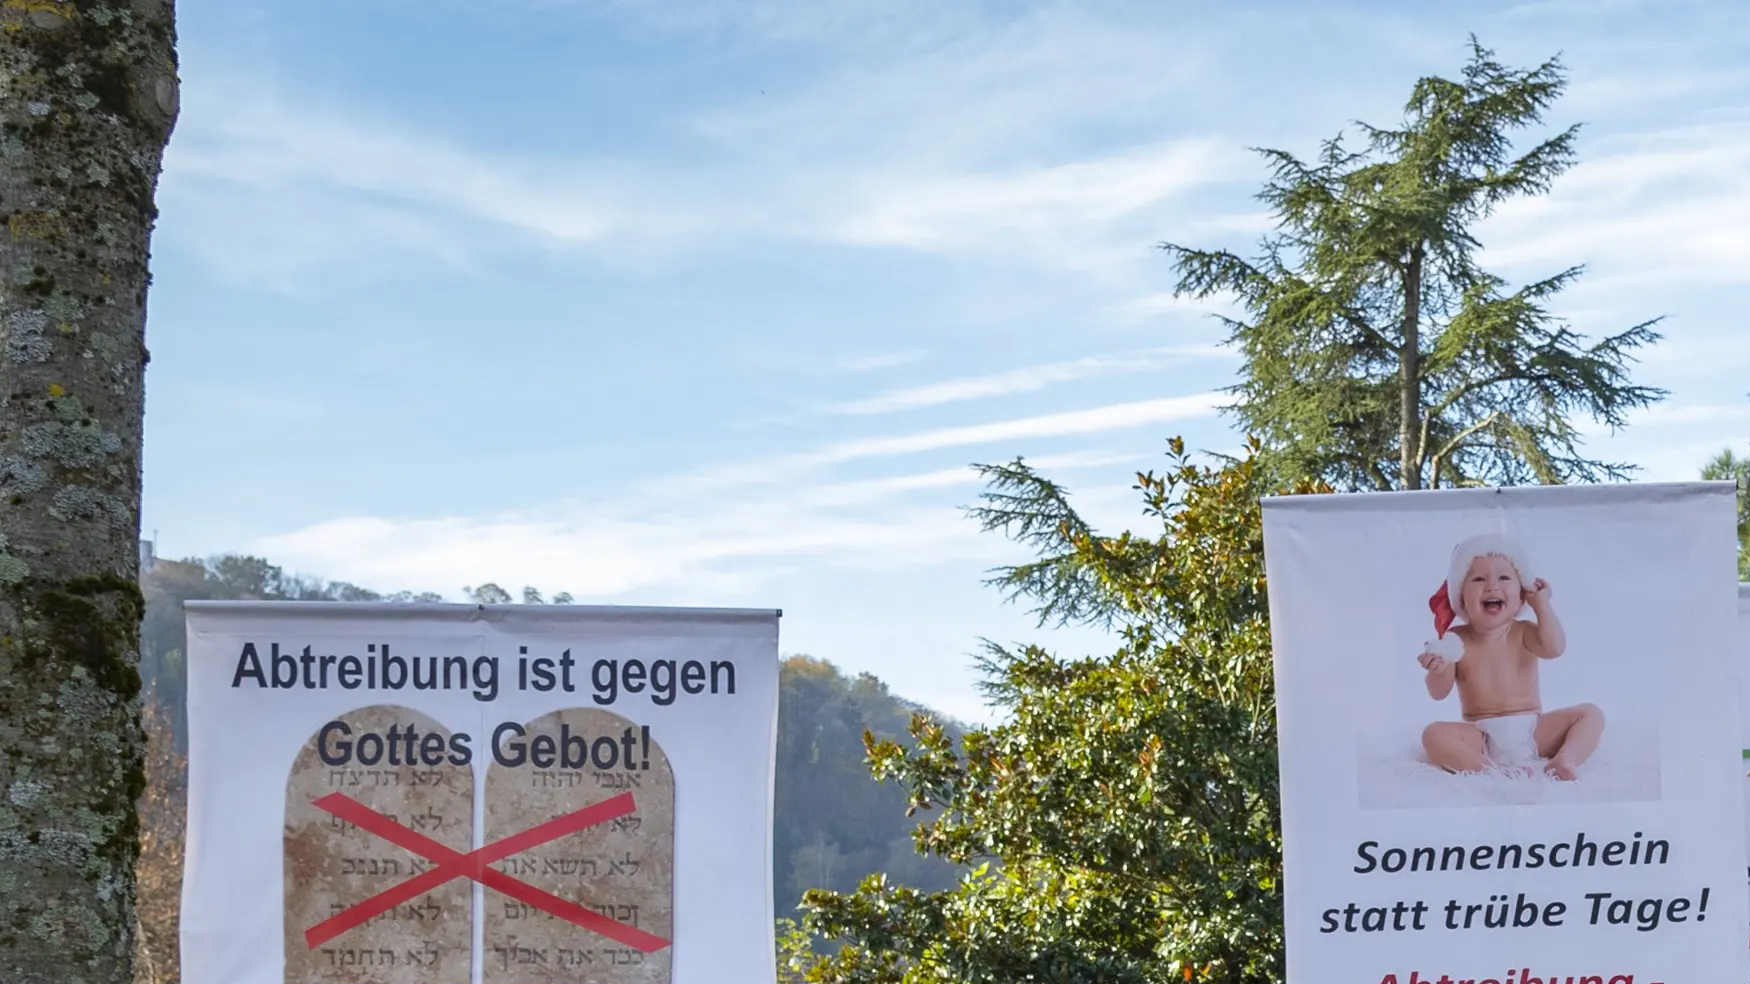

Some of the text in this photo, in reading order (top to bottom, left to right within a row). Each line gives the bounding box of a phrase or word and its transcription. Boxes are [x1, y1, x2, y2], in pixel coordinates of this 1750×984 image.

[232, 643, 734, 705] Abtreibung ist gegen
[317, 721, 649, 770] Gottes Gebot!
[1354, 832, 1669, 873] Sonnenschein
[1320, 888, 1709, 933] statt trübe Tage!
